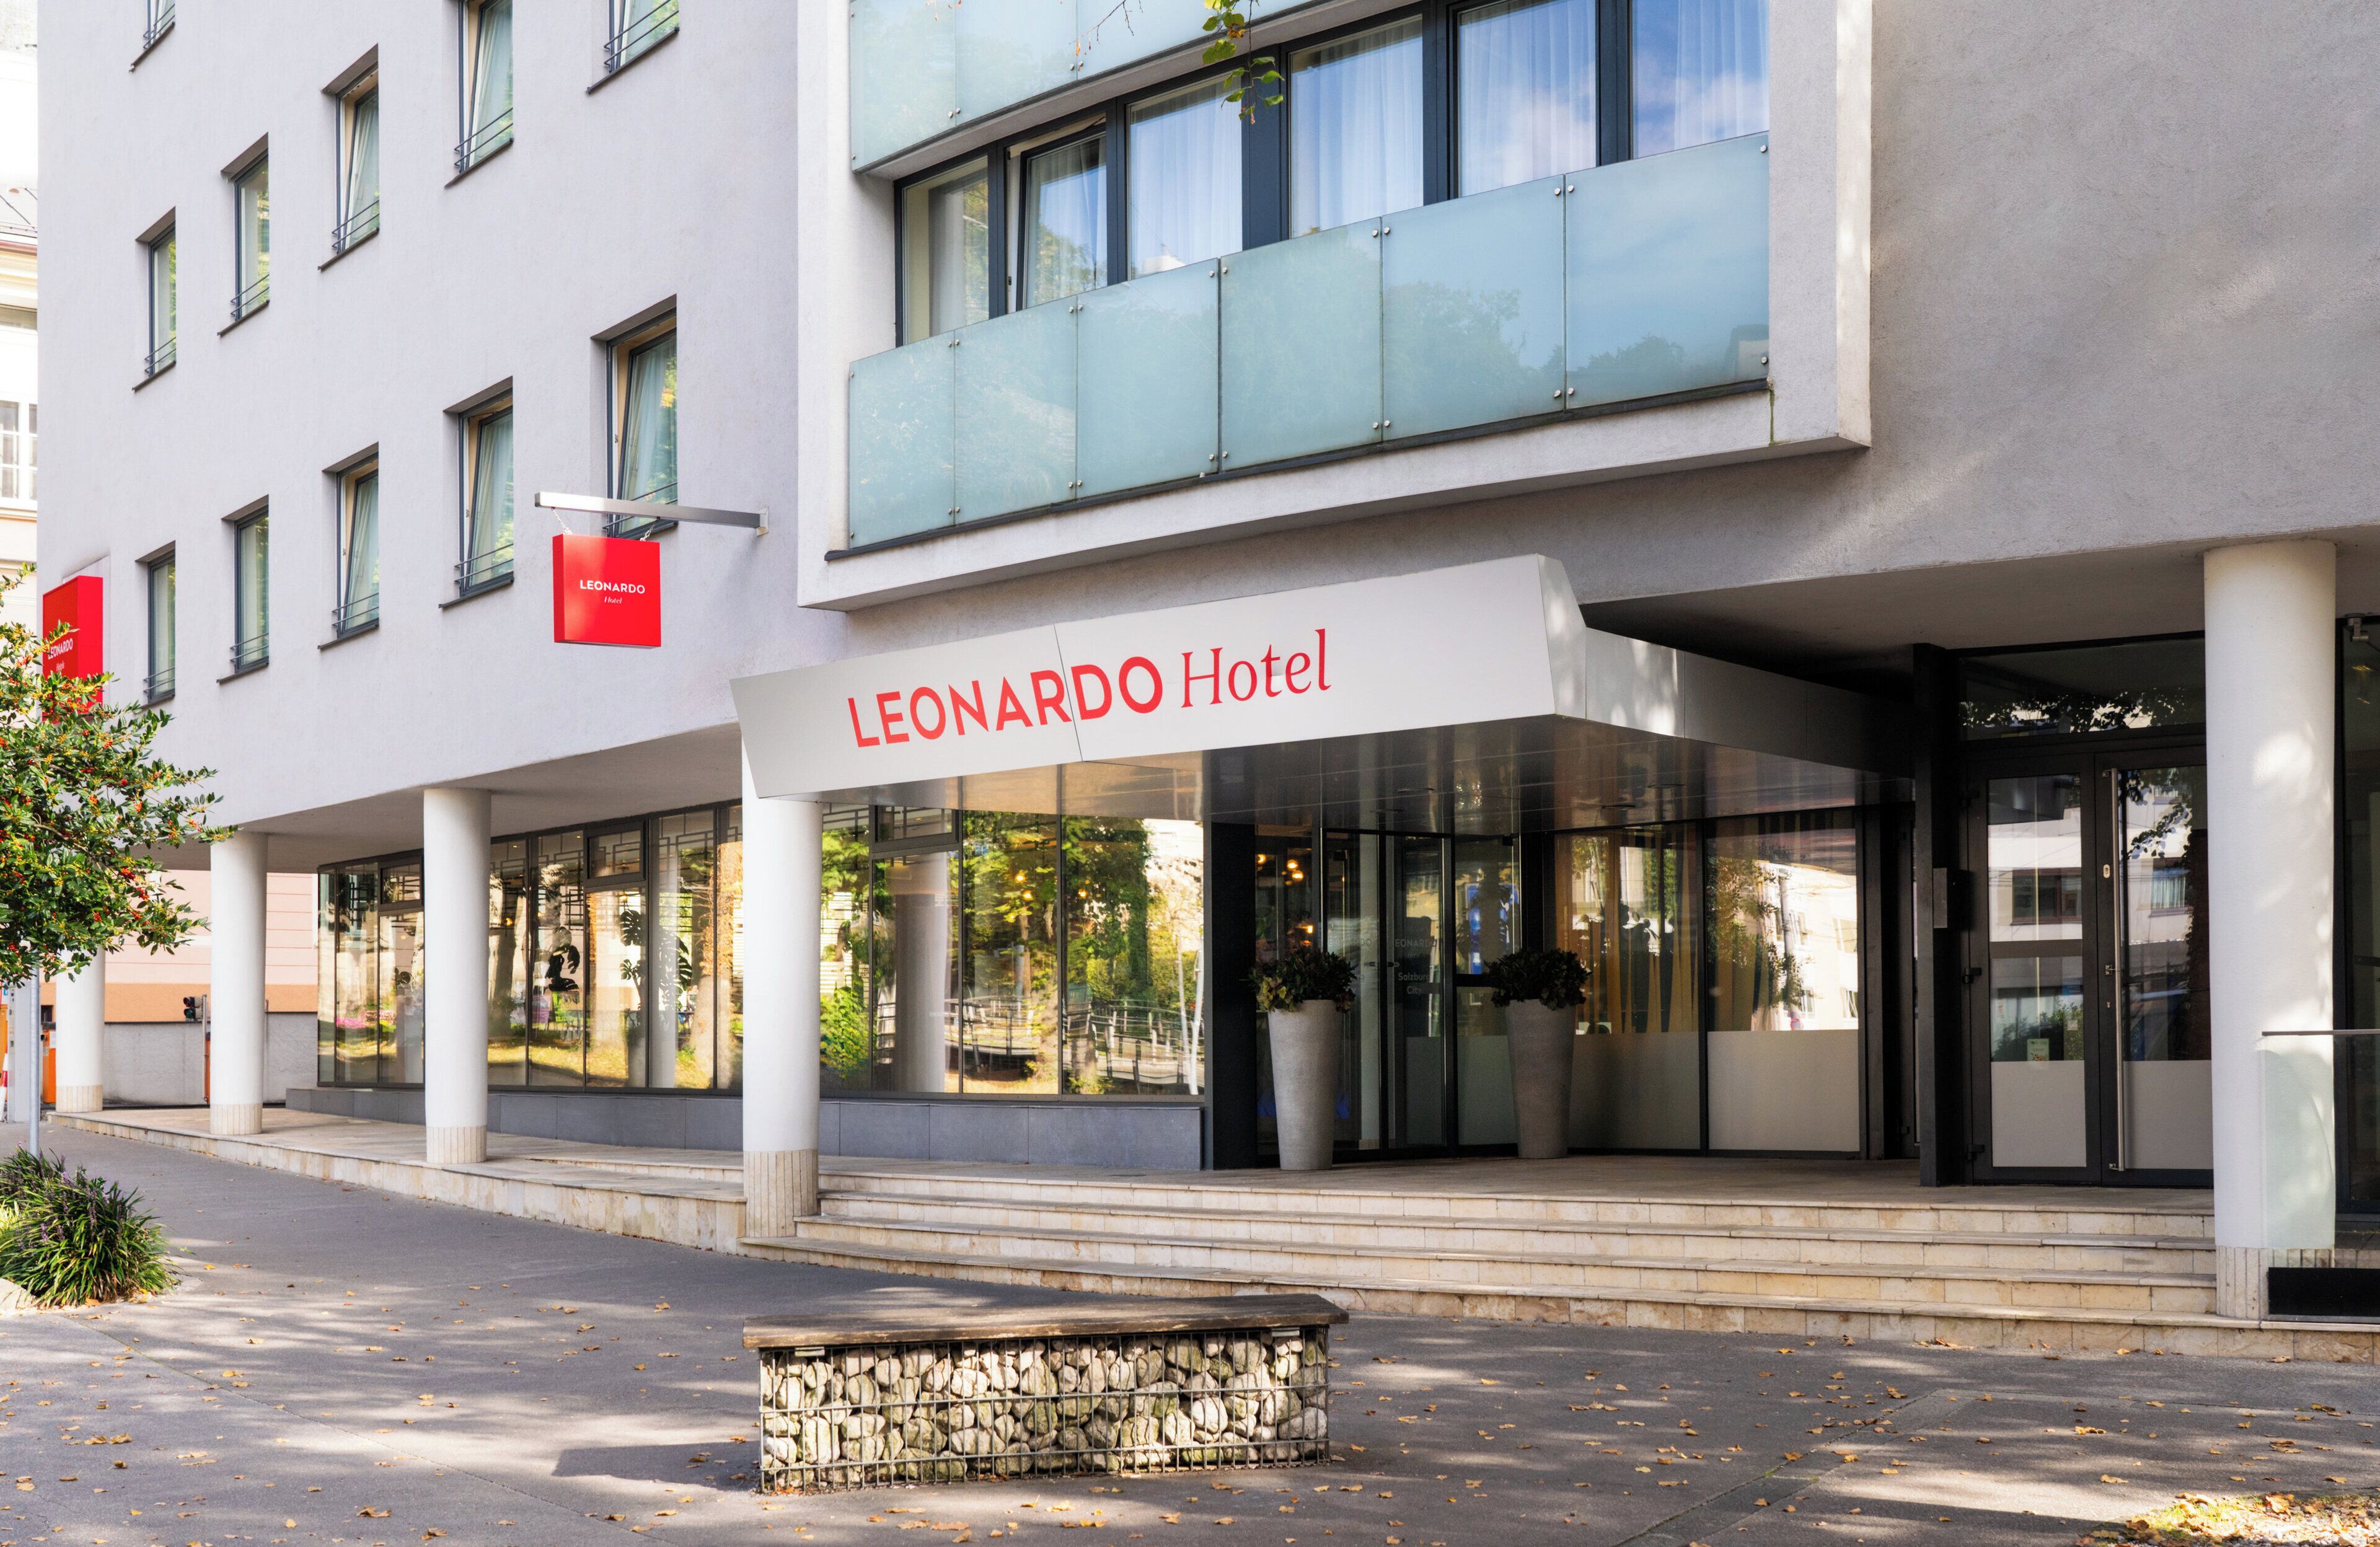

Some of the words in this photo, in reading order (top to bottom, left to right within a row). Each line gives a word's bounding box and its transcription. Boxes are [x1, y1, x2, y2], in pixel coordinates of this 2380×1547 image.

[580, 580, 646, 594] LEONARDO
[48, 638, 73, 660] LEONARDO
[848, 656, 1163, 748] LEONARDO
[1181, 628, 1332, 708] Hotel
[1407, 985, 1422, 996] City
